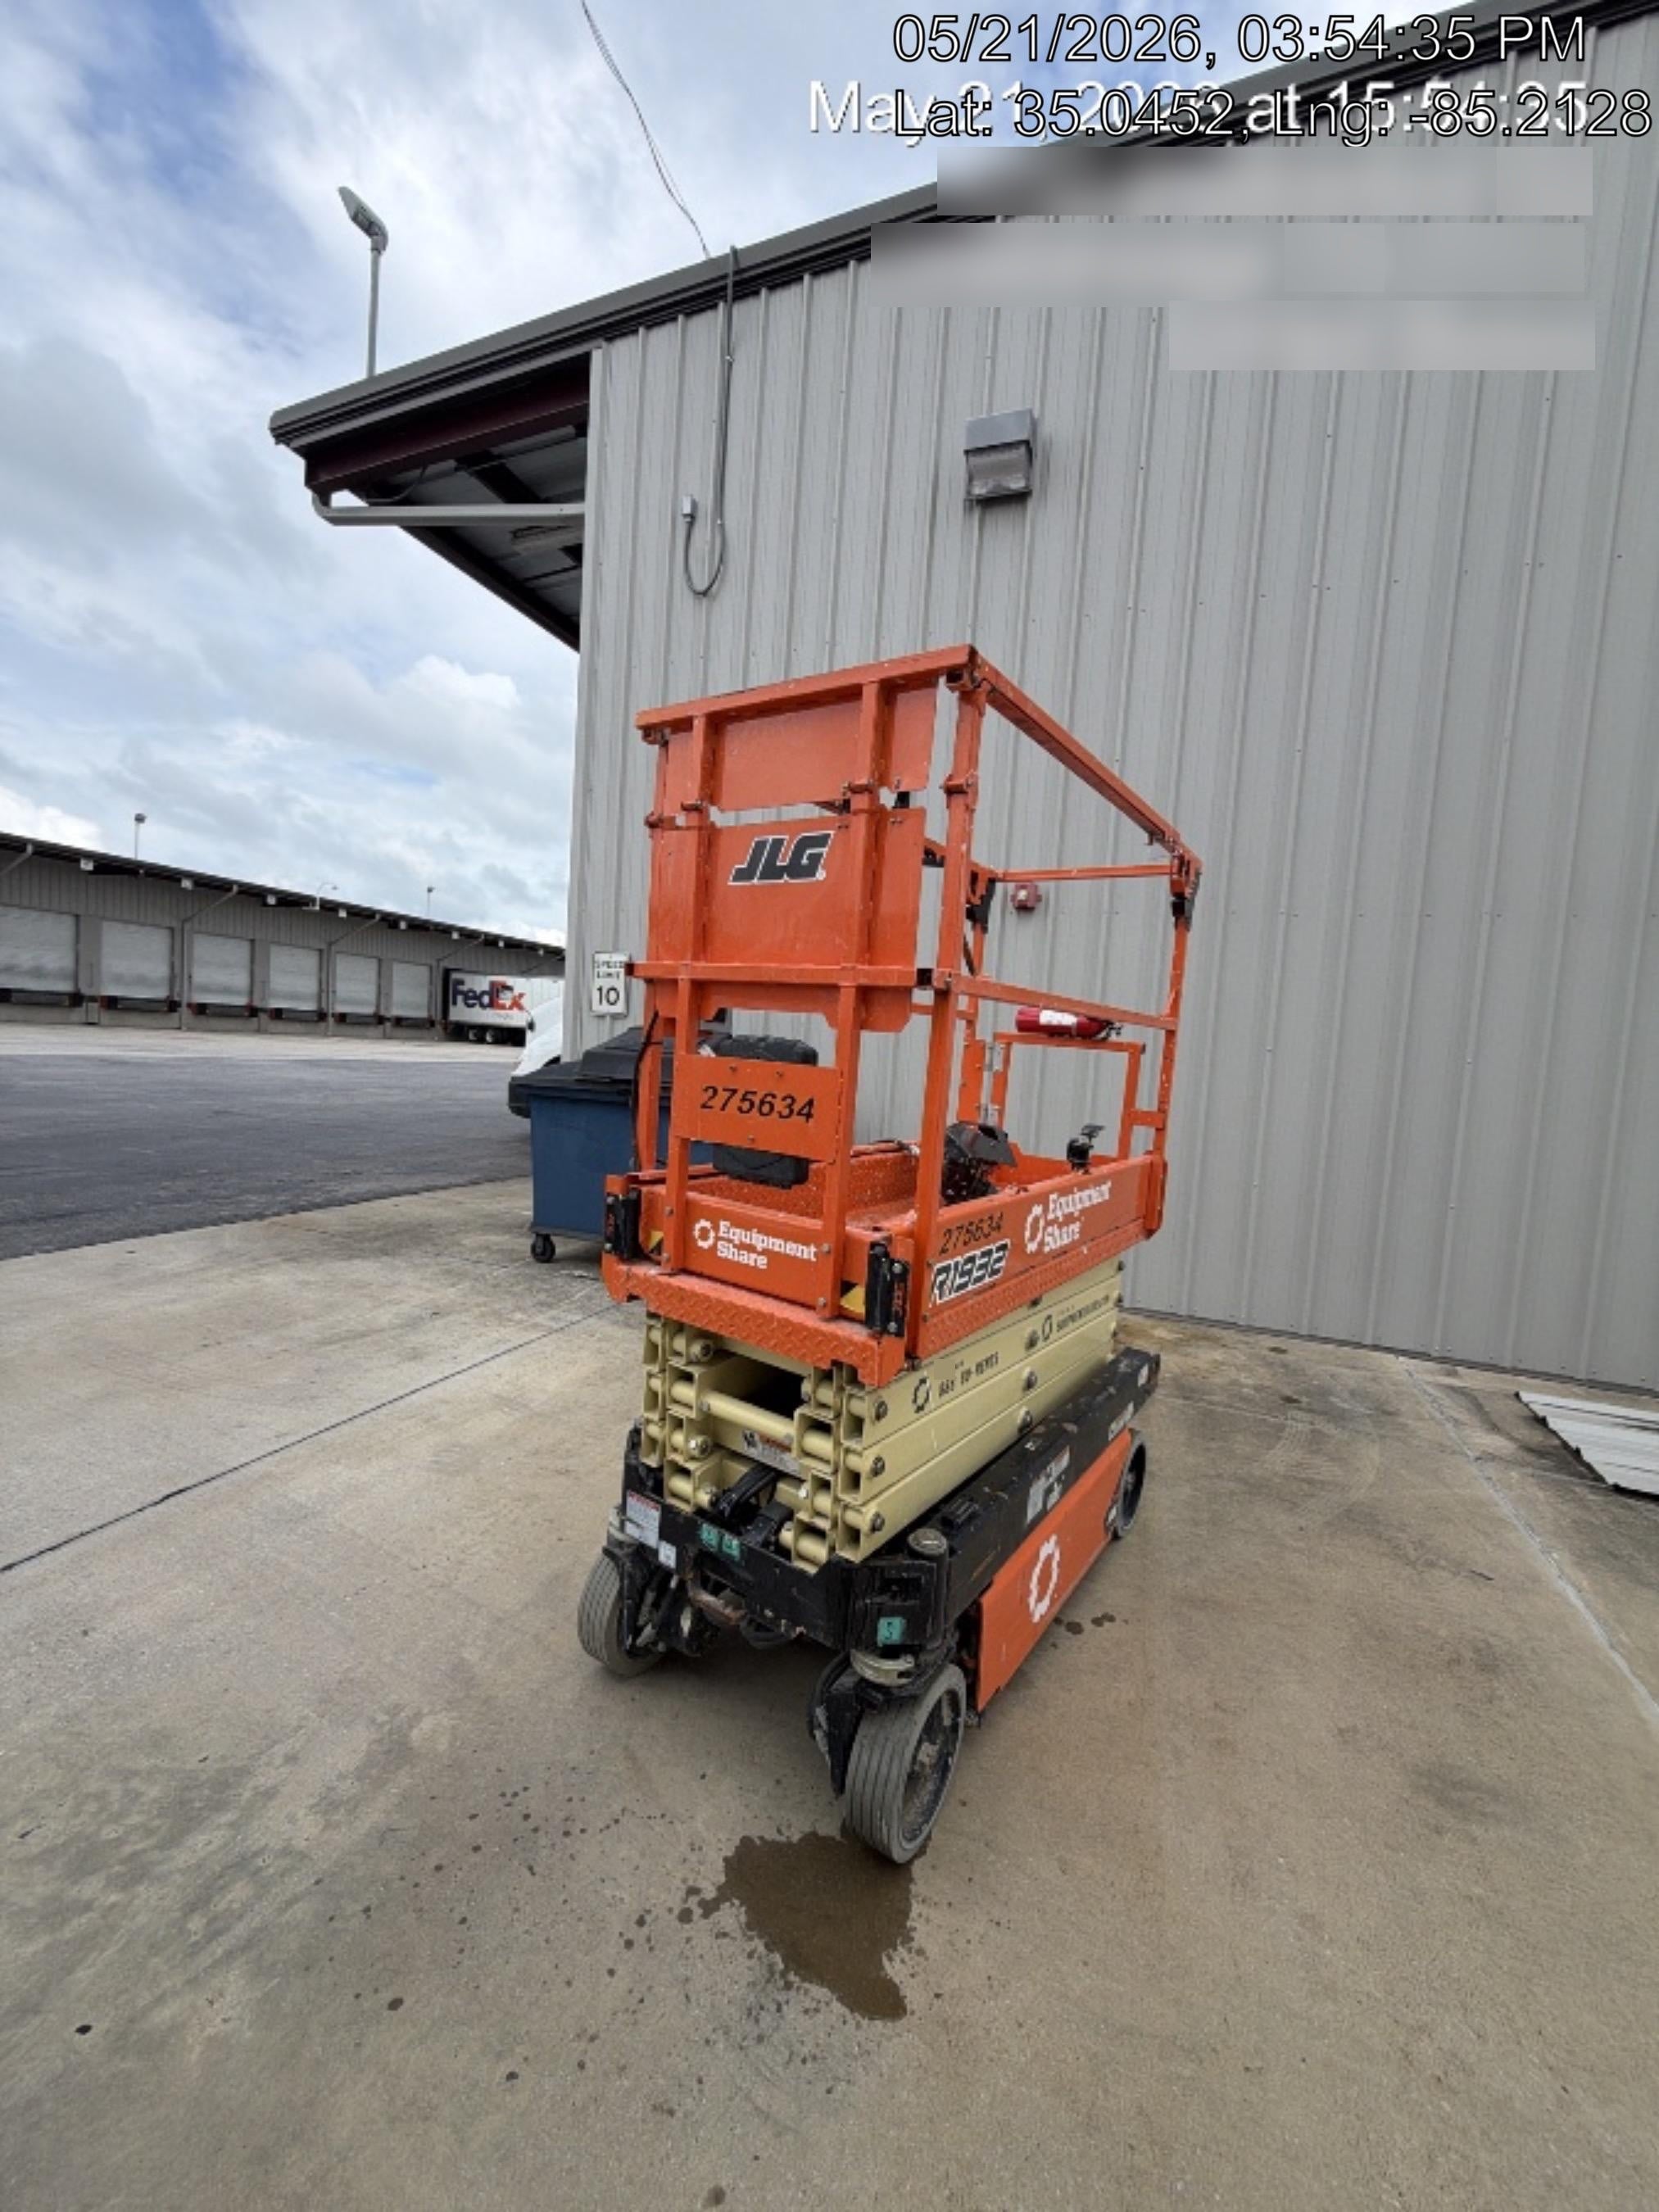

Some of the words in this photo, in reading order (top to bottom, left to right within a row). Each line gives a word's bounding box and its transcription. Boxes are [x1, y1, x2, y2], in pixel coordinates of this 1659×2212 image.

[728, 830, 835, 885] JLG
[451, 977, 526, 1010] FedEx
[596, 985, 620, 1006] 10
[700, 1086, 816, 1124] 275634
[1047, 1180, 1112, 1222] Equipment
[718, 1219, 818, 1262] Equipment
[939, 1212, 1004, 1255] 275634
[1044, 1221, 1081, 1253] Share
[716, 1240, 768, 1269] Share
